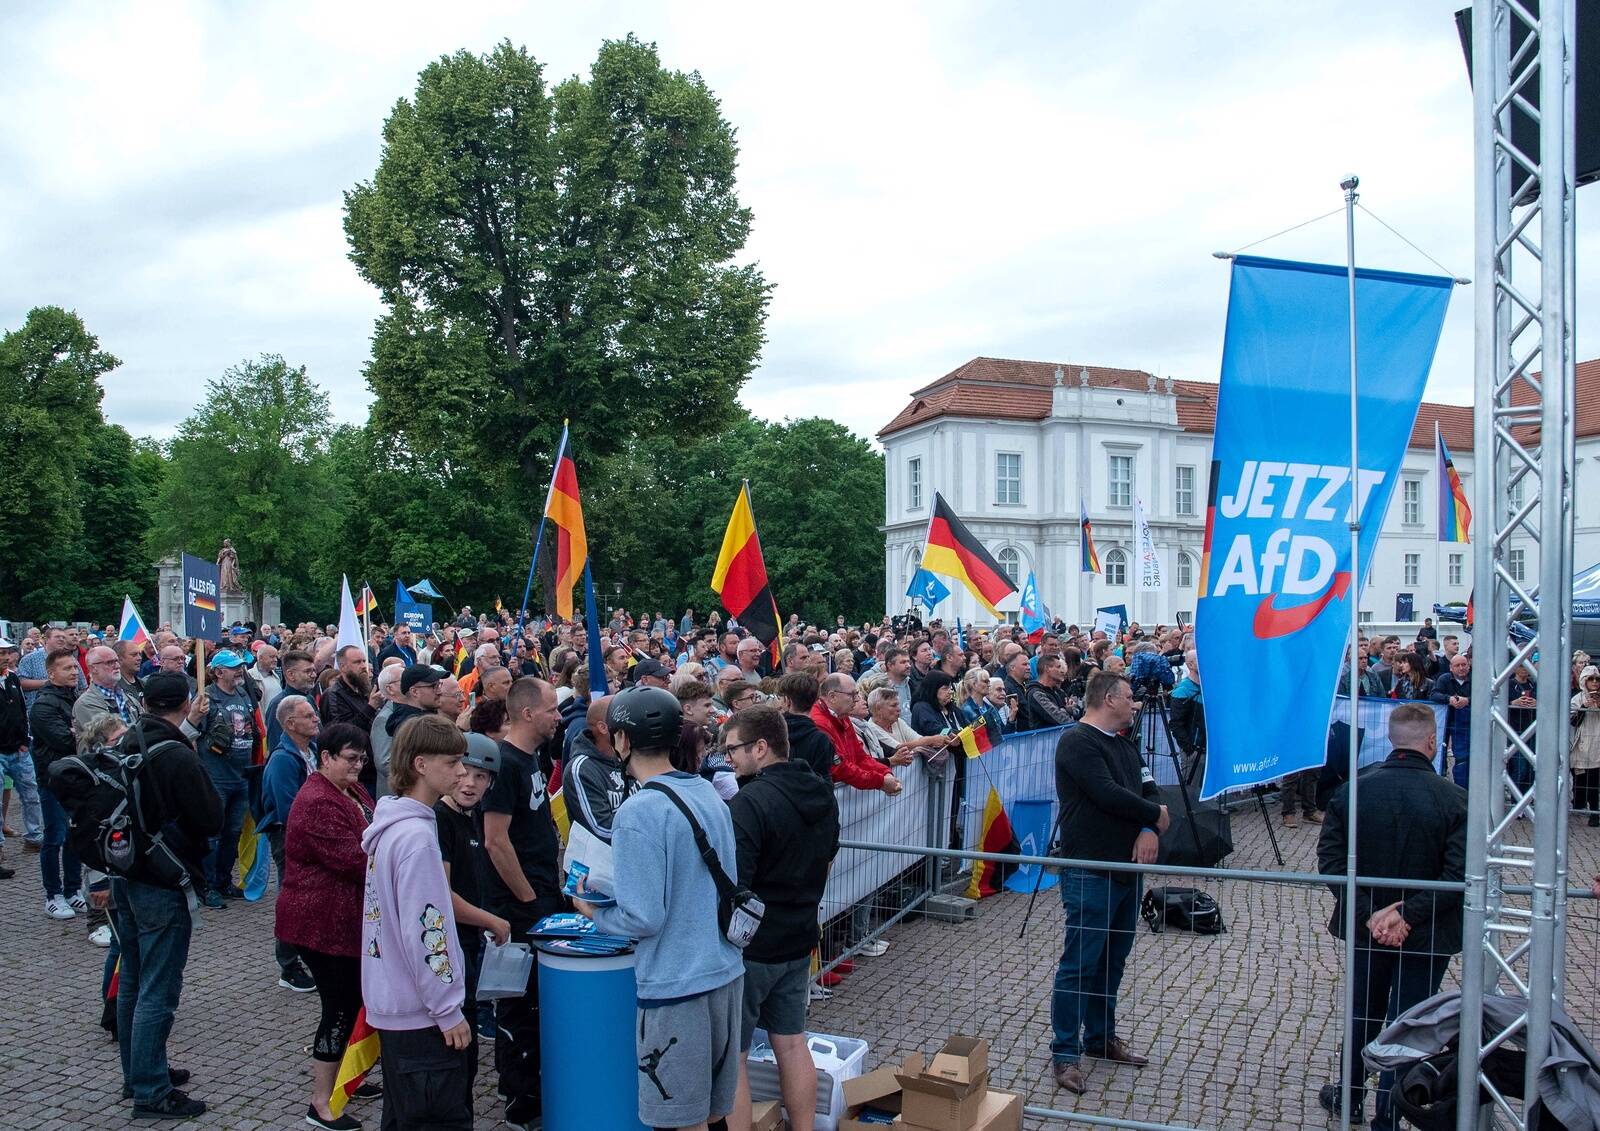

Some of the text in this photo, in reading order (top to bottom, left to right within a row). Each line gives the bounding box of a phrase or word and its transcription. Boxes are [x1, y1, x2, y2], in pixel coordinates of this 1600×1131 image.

[1221, 460, 1386, 524] JETZT
[188, 577, 217, 597] ALLES FÜR
[1213, 528, 1337, 597] AfD
